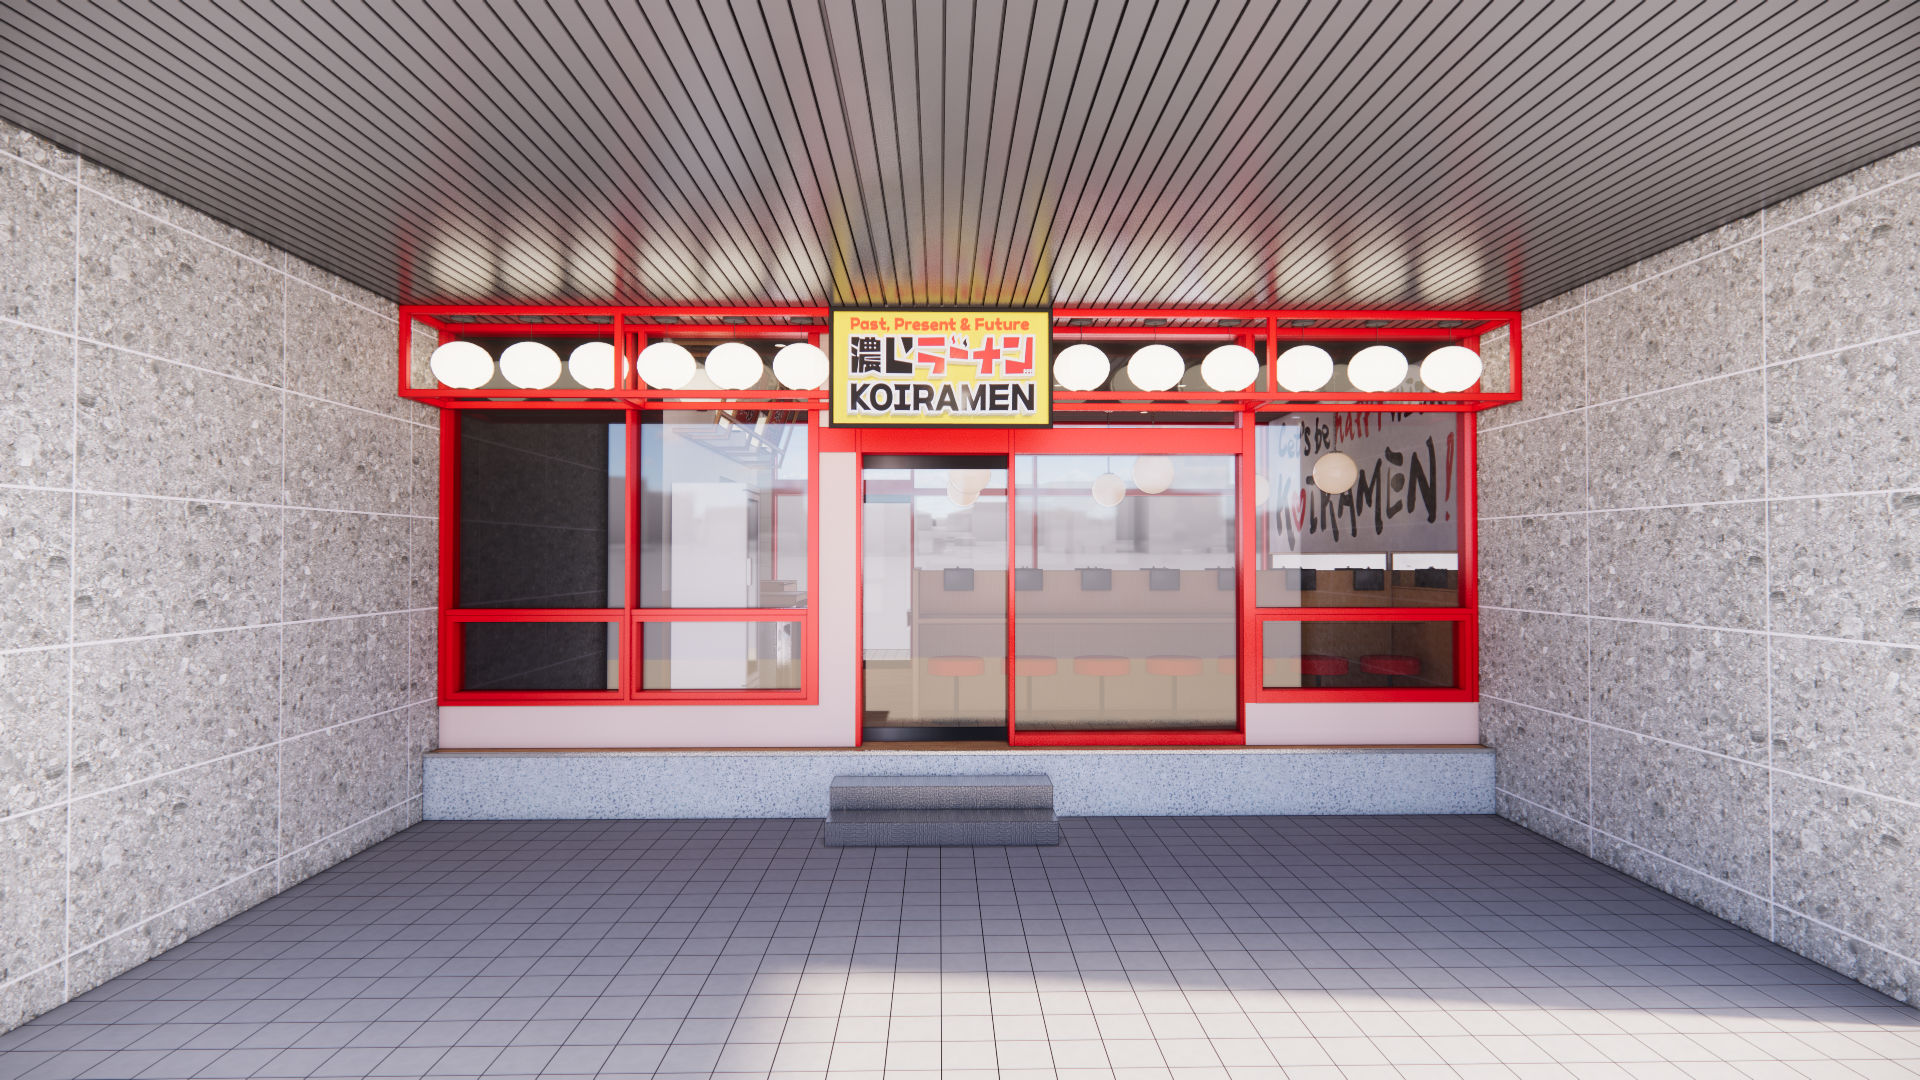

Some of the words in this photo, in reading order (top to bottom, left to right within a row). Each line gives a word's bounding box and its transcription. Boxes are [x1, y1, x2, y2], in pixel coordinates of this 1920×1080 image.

[850, 317, 890, 332] Past,
[894, 317, 957, 331] Present
[960, 317, 971, 331] &
[975, 317, 1030, 331] Future
[850, 383, 1035, 411] KOIRAMEN
[1315, 416, 1331, 455] be
